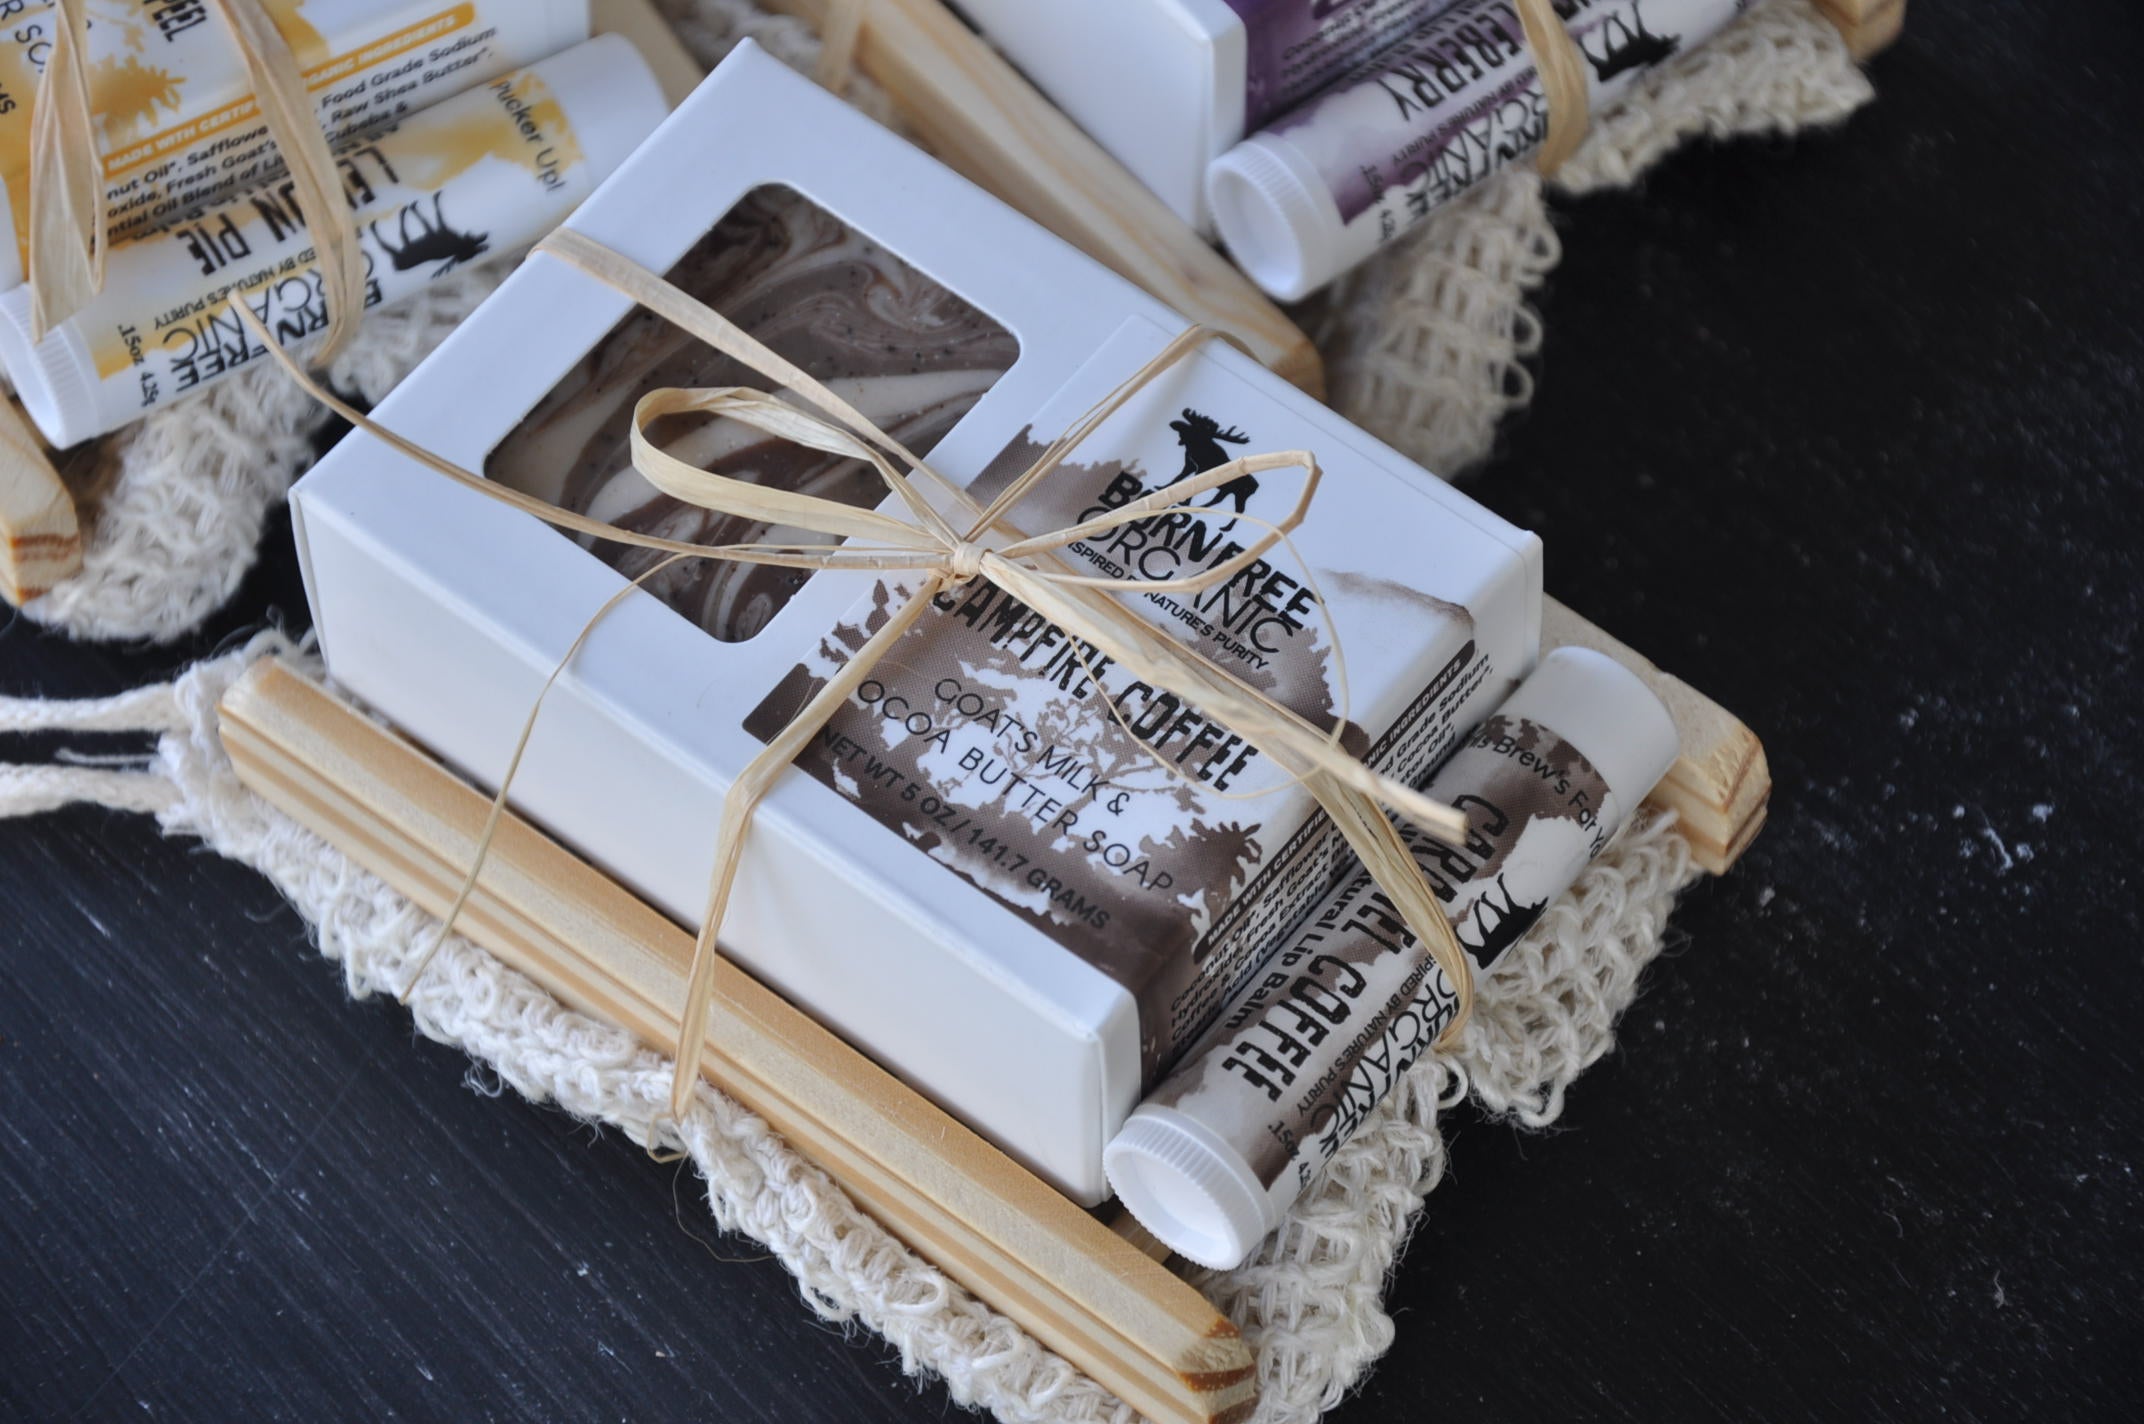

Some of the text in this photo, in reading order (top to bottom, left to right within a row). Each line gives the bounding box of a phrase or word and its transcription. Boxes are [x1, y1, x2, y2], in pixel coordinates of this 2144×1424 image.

[143, 0, 207, 43] EEL
[321, 26, 497, 109] Food Grade Sodium
[199, 104, 257, 133] CERTIF
[331, 101, 370, 123] Raw
[373, 81, 418, 105] Shea
[187, 125, 269, 165] Safflowe
[536, 146, 567, 192] Up!
[165, 167, 217, 193] Fresh
[176, 212, 252, 276] PIE
[153, 296, 205, 330] PURITY
[1212, 630, 1269, 671] PURITY
[1389, 658, 1462, 744] INGREDIENTS
[1397, 711, 1437, 758] Grade
[1439, 654, 1489, 712] Sodium
[934, 678, 1131, 817] GOAT'S MILK &
[1107, 680, 1260, 792] COFFEE
[1397, 726, 1438, 774] Cocoa
[856, 679, 1174, 892] OCOA BUTTER SOAP
[1493, 736, 1570, 795] Brew's
[1568, 789, 1597, 832] For
[1589, 827, 1605, 859] Yo
[822, 724, 868, 763] NET
[863, 755, 906, 790] WT
[900, 783, 922, 802] 5
[918, 796, 958, 826] OZ
[1026, 868, 1112, 930] GRAMS
[1208, 810, 1327, 945] MADE WITH CERTIFIE
[1245, 897, 1283, 943] Fresh
[1286, 848, 1330, 898] Goat's
[1279, 864, 1330, 921] Extract
[1171, 940, 1230, 1012] Coconut
[1263, 832, 1329, 908] Safflower
[1224, 870, 1373, 1029] tural Lip Balm
[1221, 954, 1367, 1102] COFFEE
[1385, 993, 1402, 1017] BY
[1338, 1010, 1389, 1072] NATURE'S
[1297, 1069, 1338, 1117] PURITY
